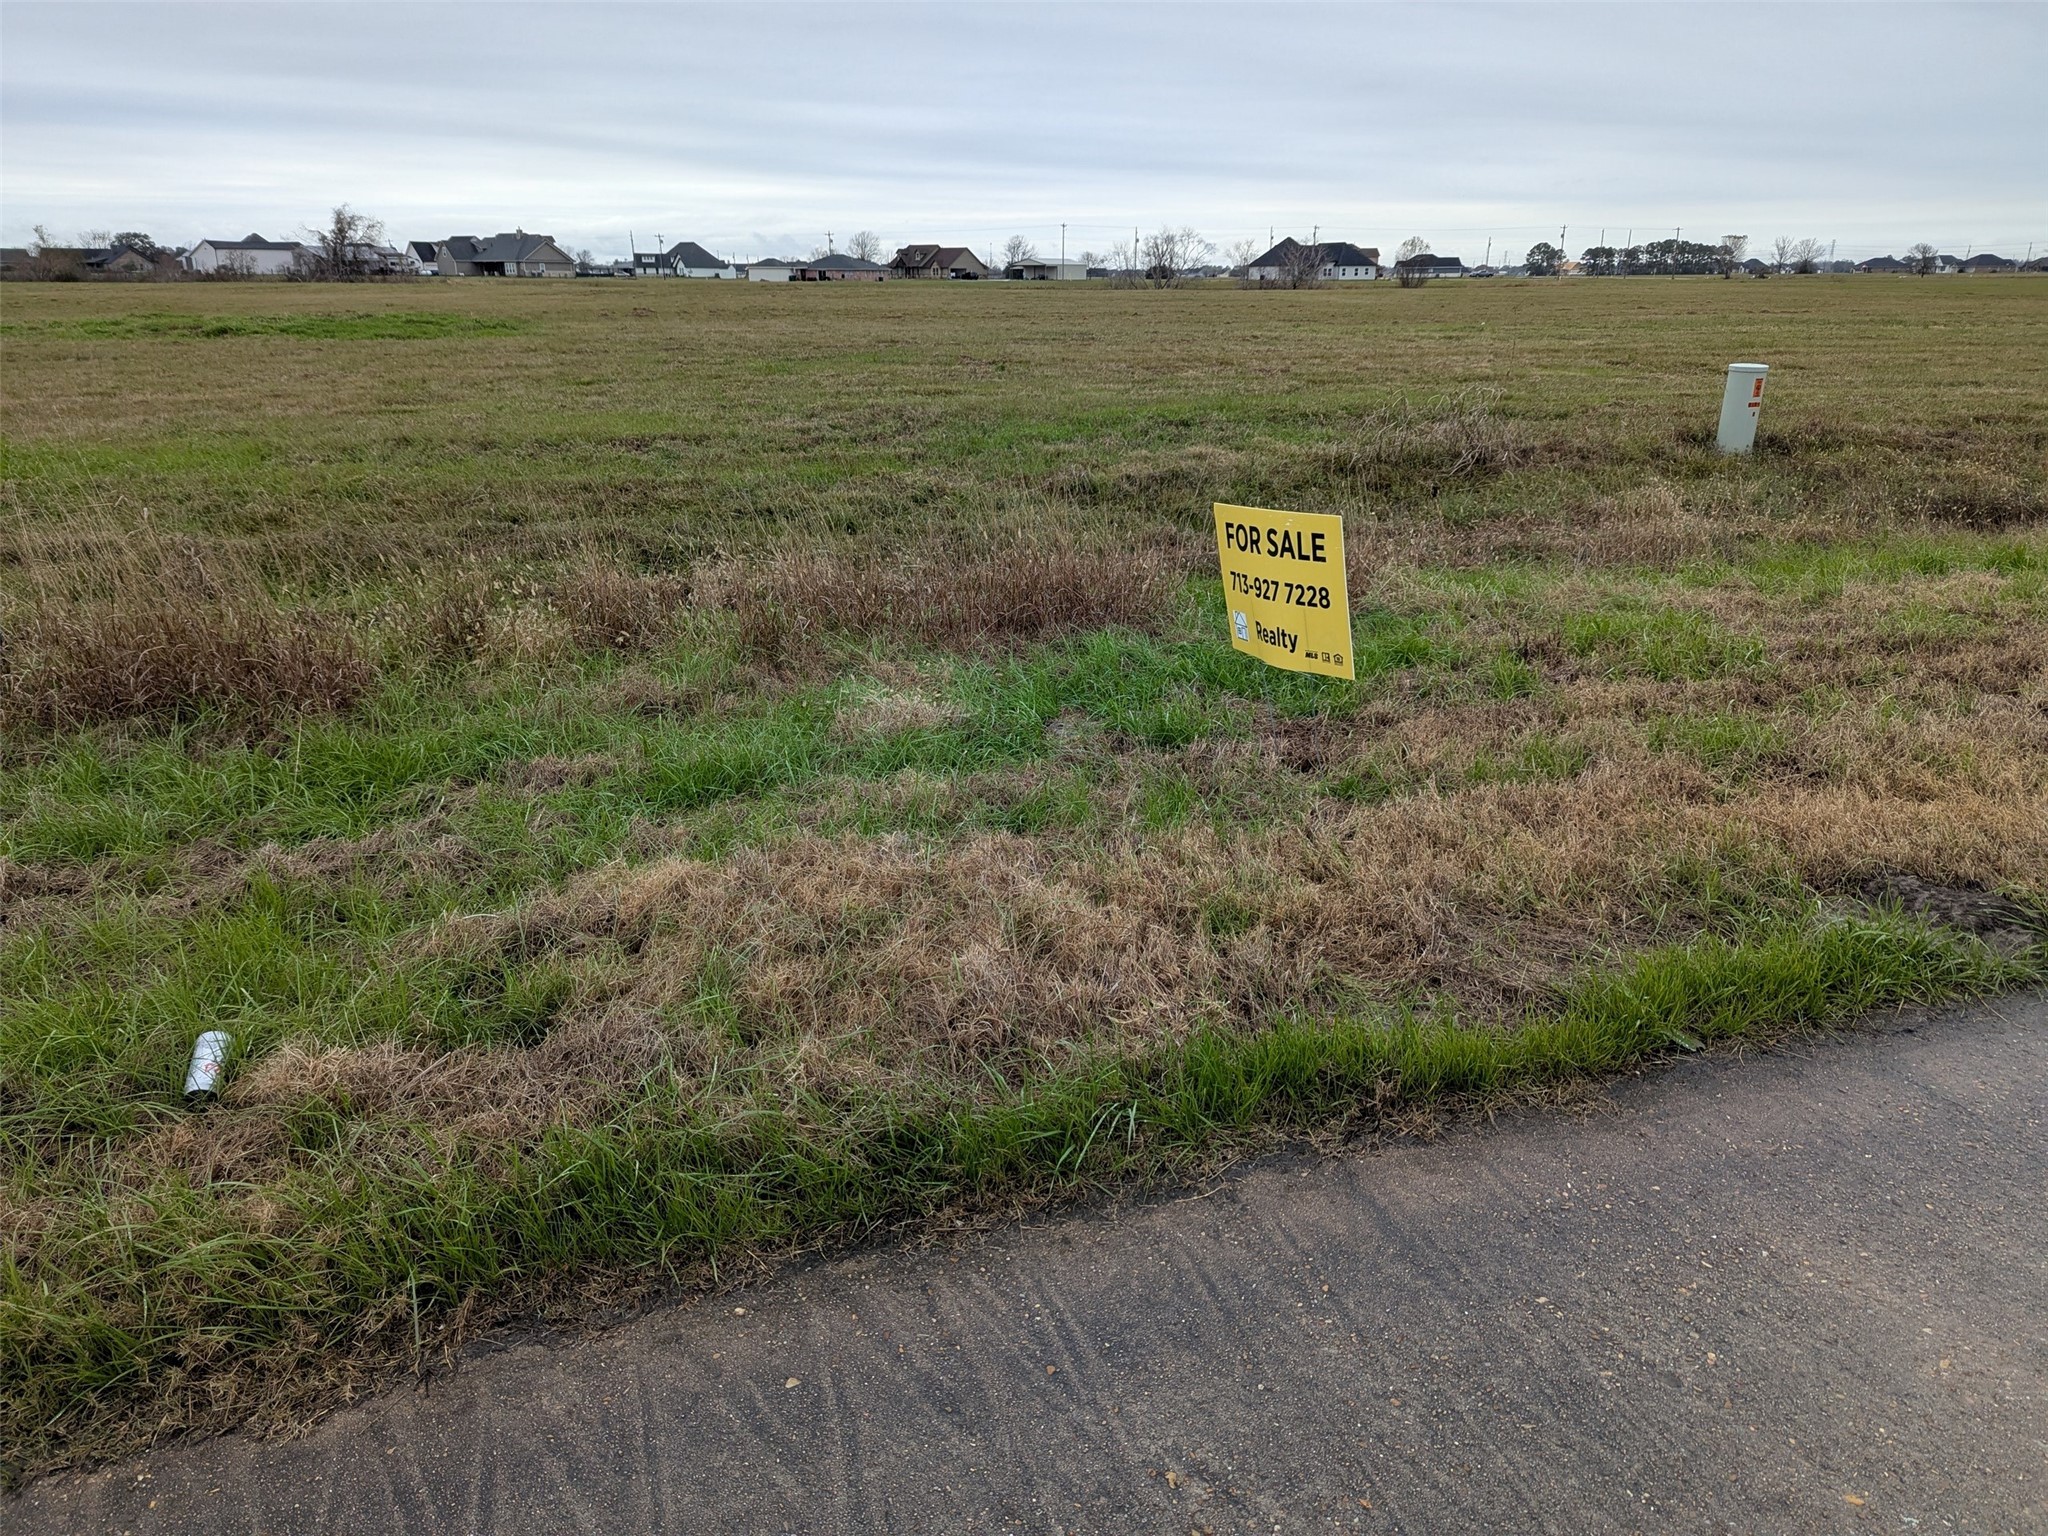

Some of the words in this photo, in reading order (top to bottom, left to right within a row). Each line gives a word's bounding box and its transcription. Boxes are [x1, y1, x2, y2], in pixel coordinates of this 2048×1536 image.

[1225, 522, 1261, 555] FOR
[1267, 528, 1327, 563] SALE
[1229, 571, 1279, 602] 713-927
[1284, 582, 1331, 609] 7228
[1255, 620, 1298, 653] Realty
